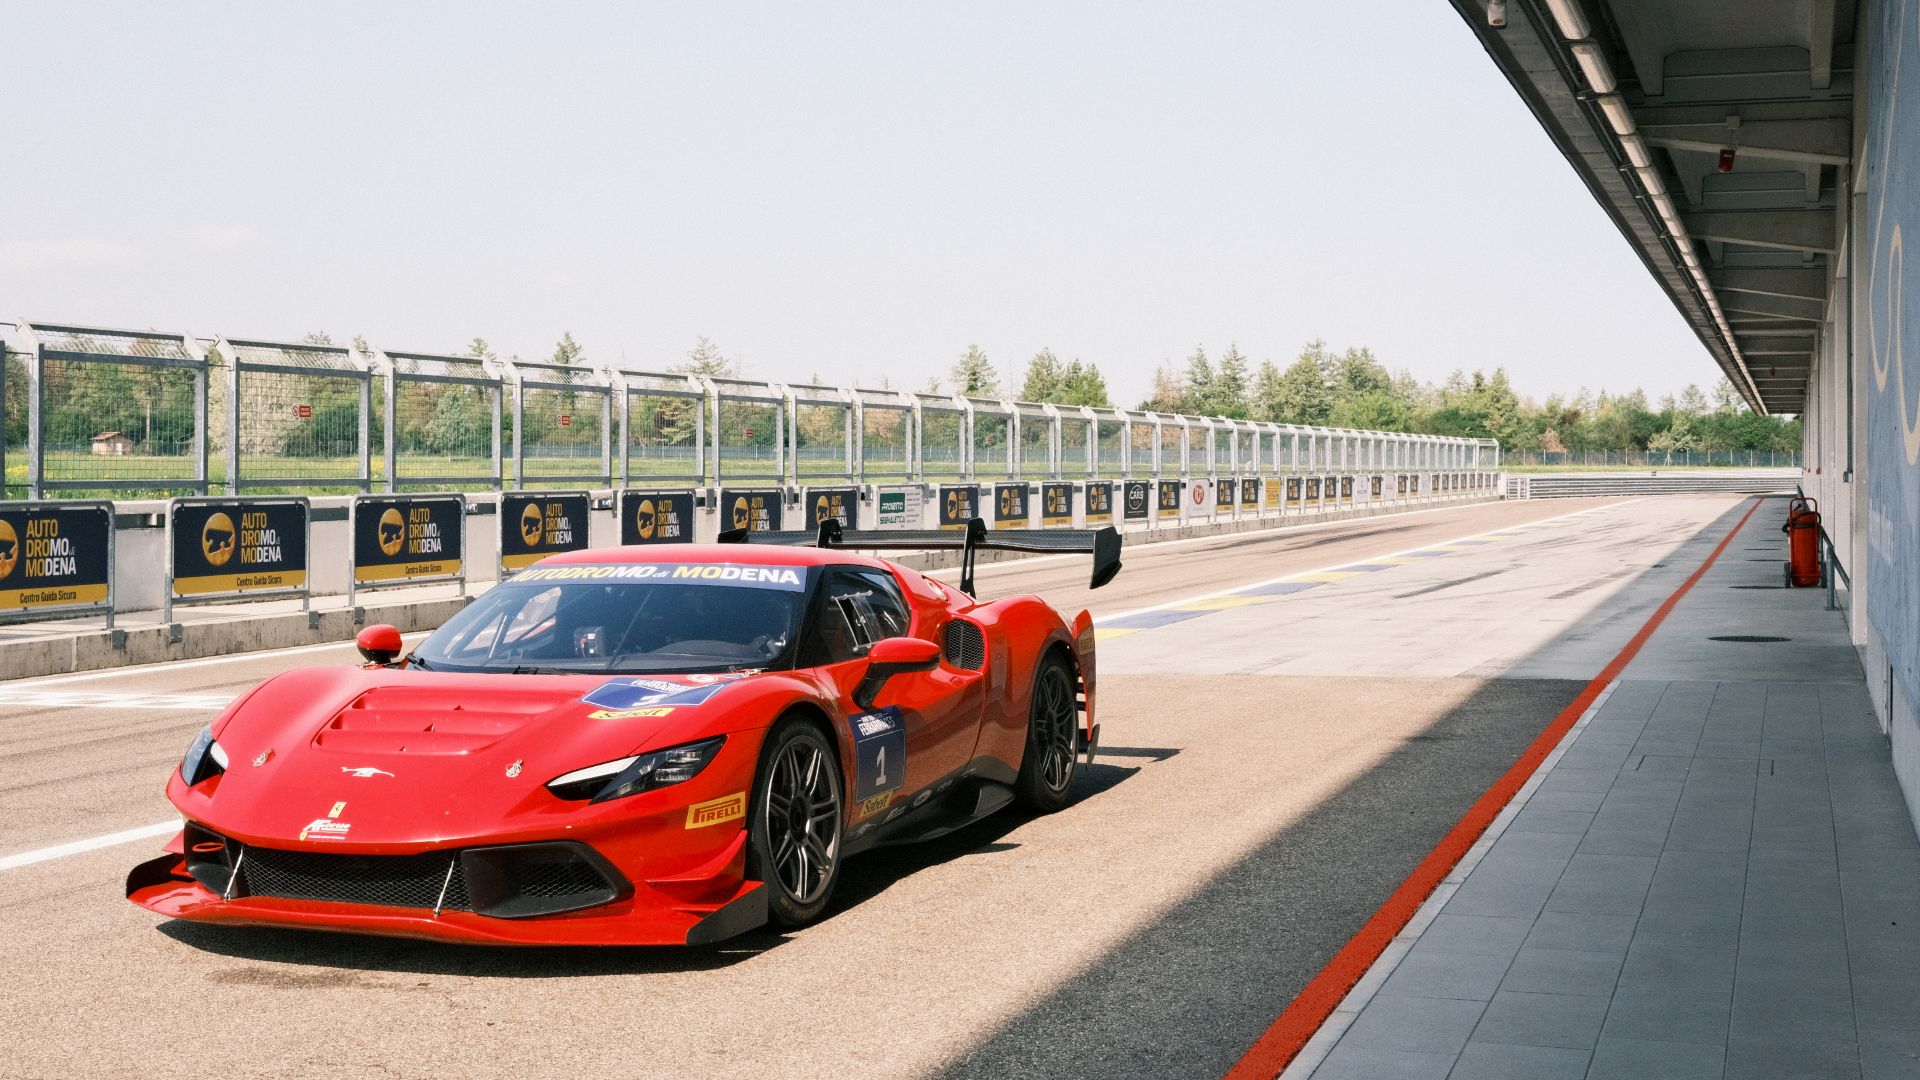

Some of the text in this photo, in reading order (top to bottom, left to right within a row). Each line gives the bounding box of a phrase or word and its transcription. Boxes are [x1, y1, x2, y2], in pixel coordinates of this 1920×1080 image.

[546, 504, 563, 516] AUTO
[658, 500, 672, 512] AUTO
[241, 512, 267, 529] AUTO
[409, 508, 430, 523] AUTO
[546, 517, 568, 530] DROMO
[658, 512, 676, 525] DROMO
[26, 519, 58, 538] AUTO
[409, 523, 437, 538] DROMO
[658, 524, 680, 537] MODENA
[241, 529, 276, 546] DROMO
[546, 530, 572, 544] MODENA
[26, 538, 69, 558] DROMO
[409, 538, 442, 554] MODENA
[241, 546, 282, 564] MODENA
[25, 557, 77, 577] MODENA
[236, 575, 282, 587] Centro Guida Sicura
[506, 566, 656, 582] AUTODROMO
[672, 566, 800, 585] MODENA
[20, 590, 77, 603] Centro Guida Sicura
[875, 745, 887, 787] 1
[693, 797, 741, 824] PIRELLI
[863, 793, 890, 815] Sabelt
